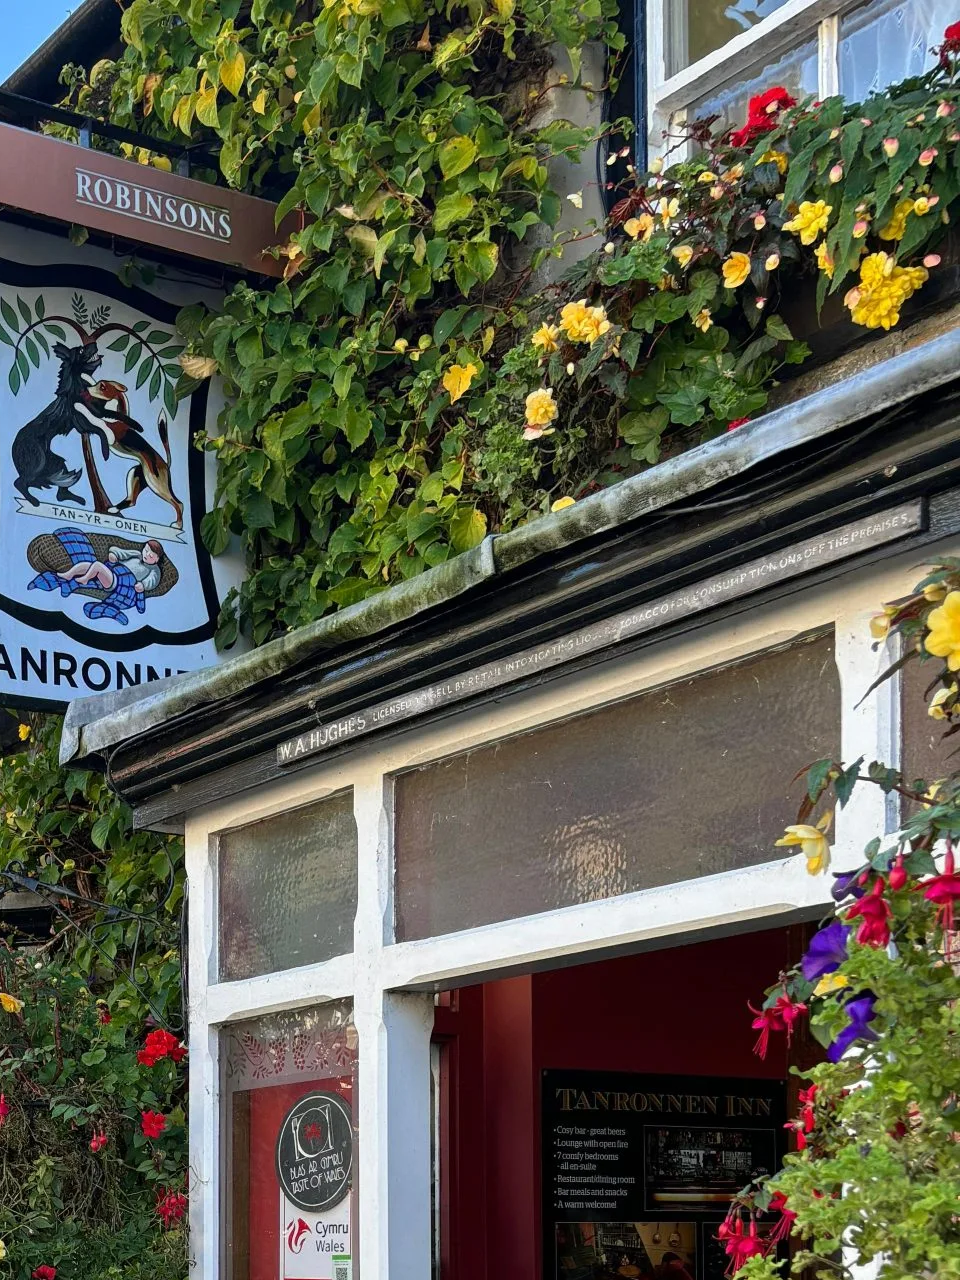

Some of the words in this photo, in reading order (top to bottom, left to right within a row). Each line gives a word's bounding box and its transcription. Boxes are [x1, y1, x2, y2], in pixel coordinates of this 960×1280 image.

[76, 172, 232, 238] ROBINSONS
[310, 716, 366, 749] HUGHES
[372, 701, 412, 722] LICENSED
[455, 679, 466, 692] BY
[468, 668, 501, 686] RETAIL
[506, 641, 574, 672] INTOXICATING
[804, 543, 826, 558] OFF
[827, 534, 849, 550] THE
[555, 1087, 719, 1114] TANRONNEN
[724, 1095, 773, 1117] INN
[557, 1126, 575, 1136] Cosy
[575, 1126, 587, 1135] bar
[590, 1128, 607, 1137] great
[607, 1127, 626, 1136] beers
[557, 1139, 583, 1148] Lounge
[584, 1139, 599, 1148] with
[599, 1141, 616, 1149] open
[616, 1140, 629, 1148] fire
[557, 1151, 562, 1160] 7
[562, 1152, 584, 1162] comfy
[585, 1152, 619, 1161] bedrooms
[290, 1164, 305, 1180] BLAS
[309, 1161, 317, 1174] AR
[560, 1162, 569, 1170] all
[569, 1163, 597, 1171] en-suite
[291, 1178, 309, 1194] TASTE
[310, 1173, 323, 1188] OF
[324, 1167, 346, 1184] WALES
[558, 1188, 569, 1196] Bar
[570, 1188, 591, 1196] meals
[591, 1188, 604, 1196] and
[605, 1188, 628, 1196] snacks
[558, 1201, 564, 1209] A
[316, 1222, 348, 1237] Cymru
[316, 1240, 345, 1252] Wales
